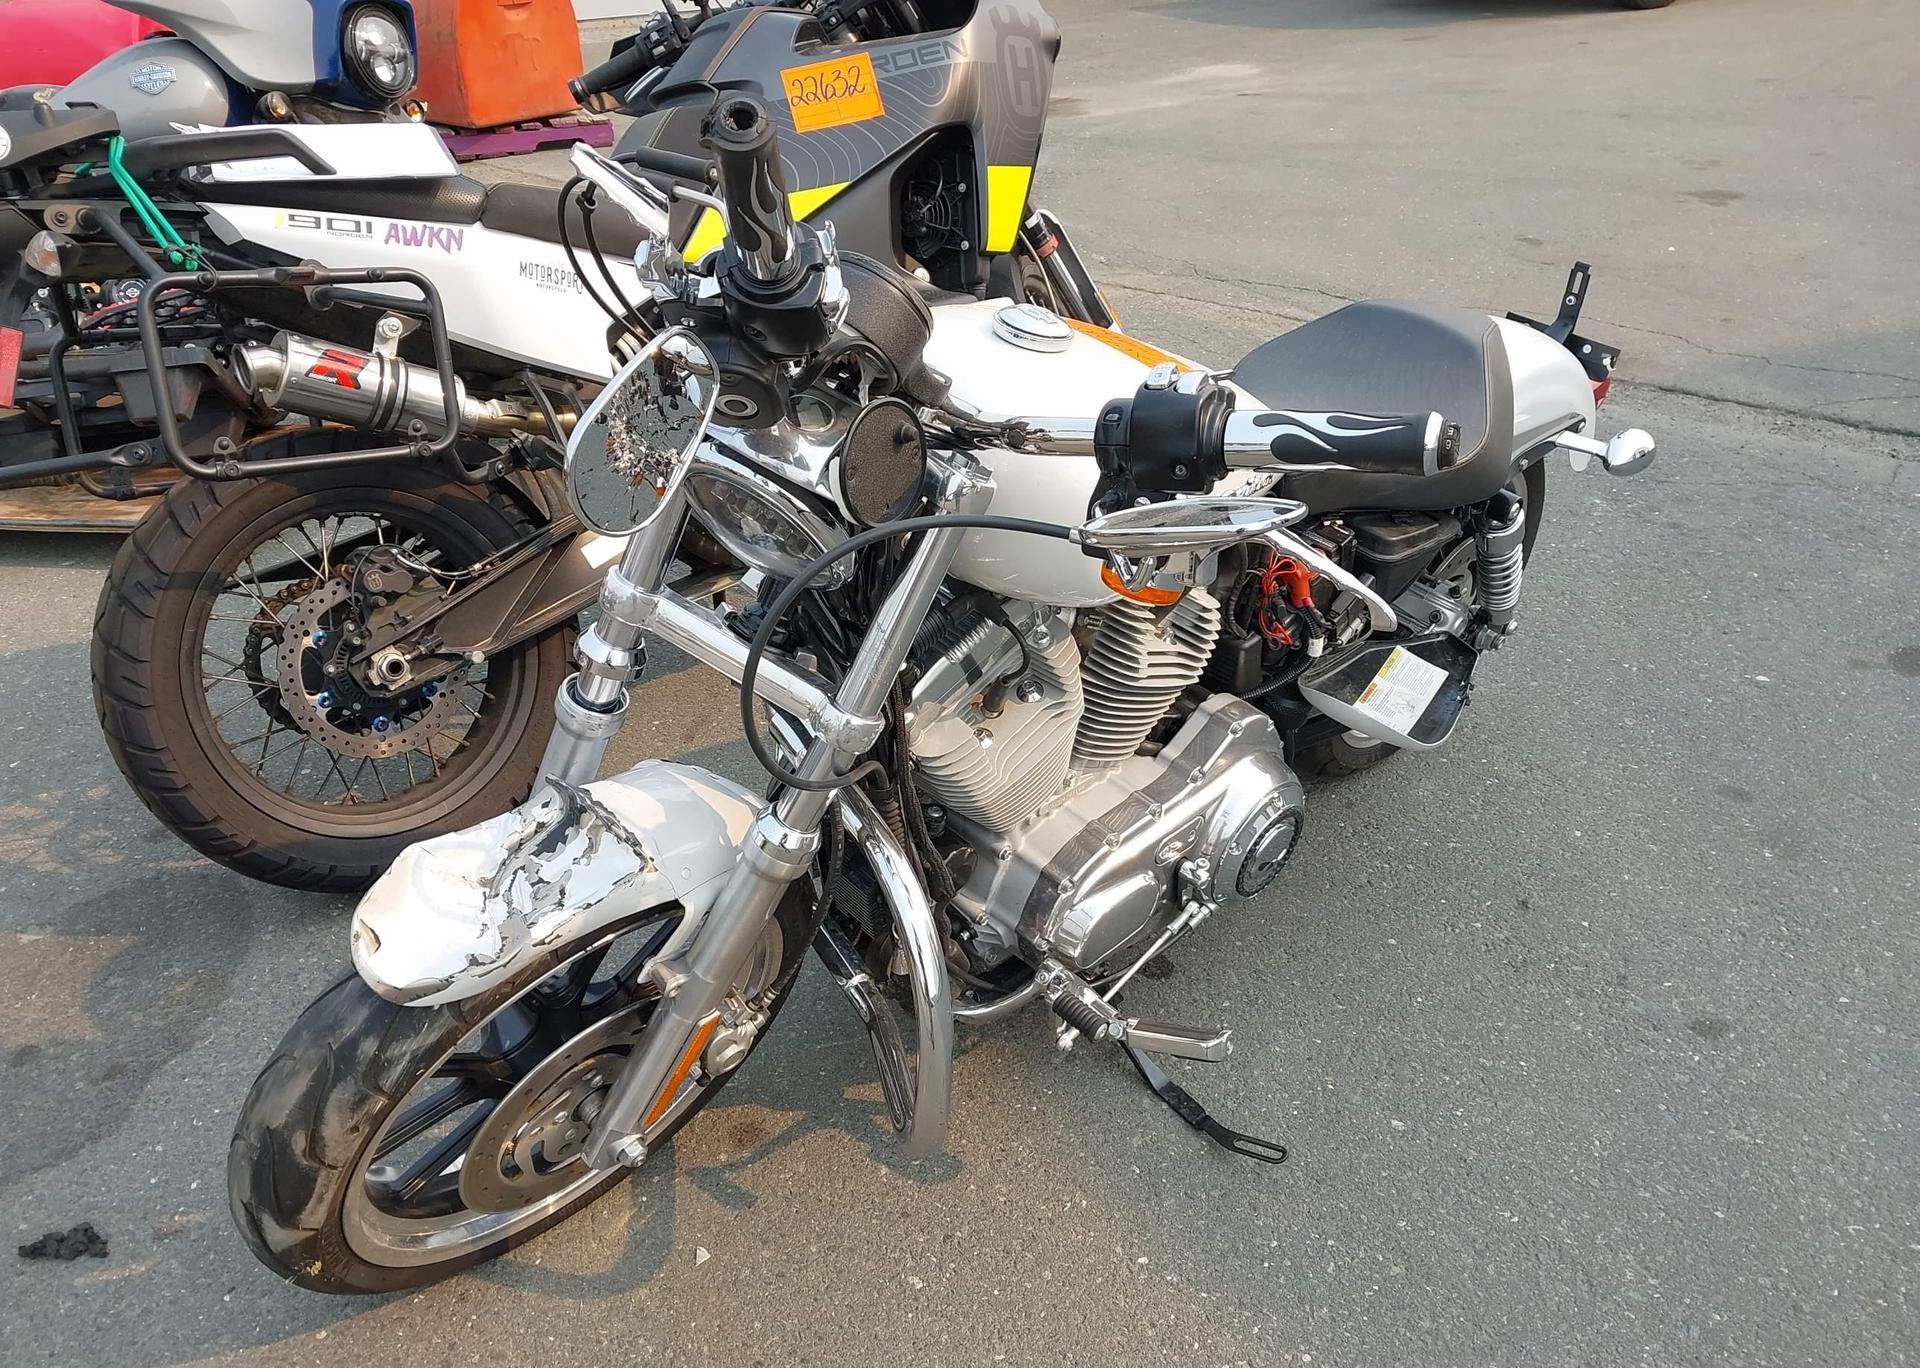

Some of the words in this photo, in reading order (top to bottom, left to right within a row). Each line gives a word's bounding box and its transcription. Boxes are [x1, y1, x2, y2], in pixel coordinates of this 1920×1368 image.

[791, 65, 866, 107] 22632
[384, 222, 464, 254] AWKN
[519, 261, 584, 295] MOTORSPOR
